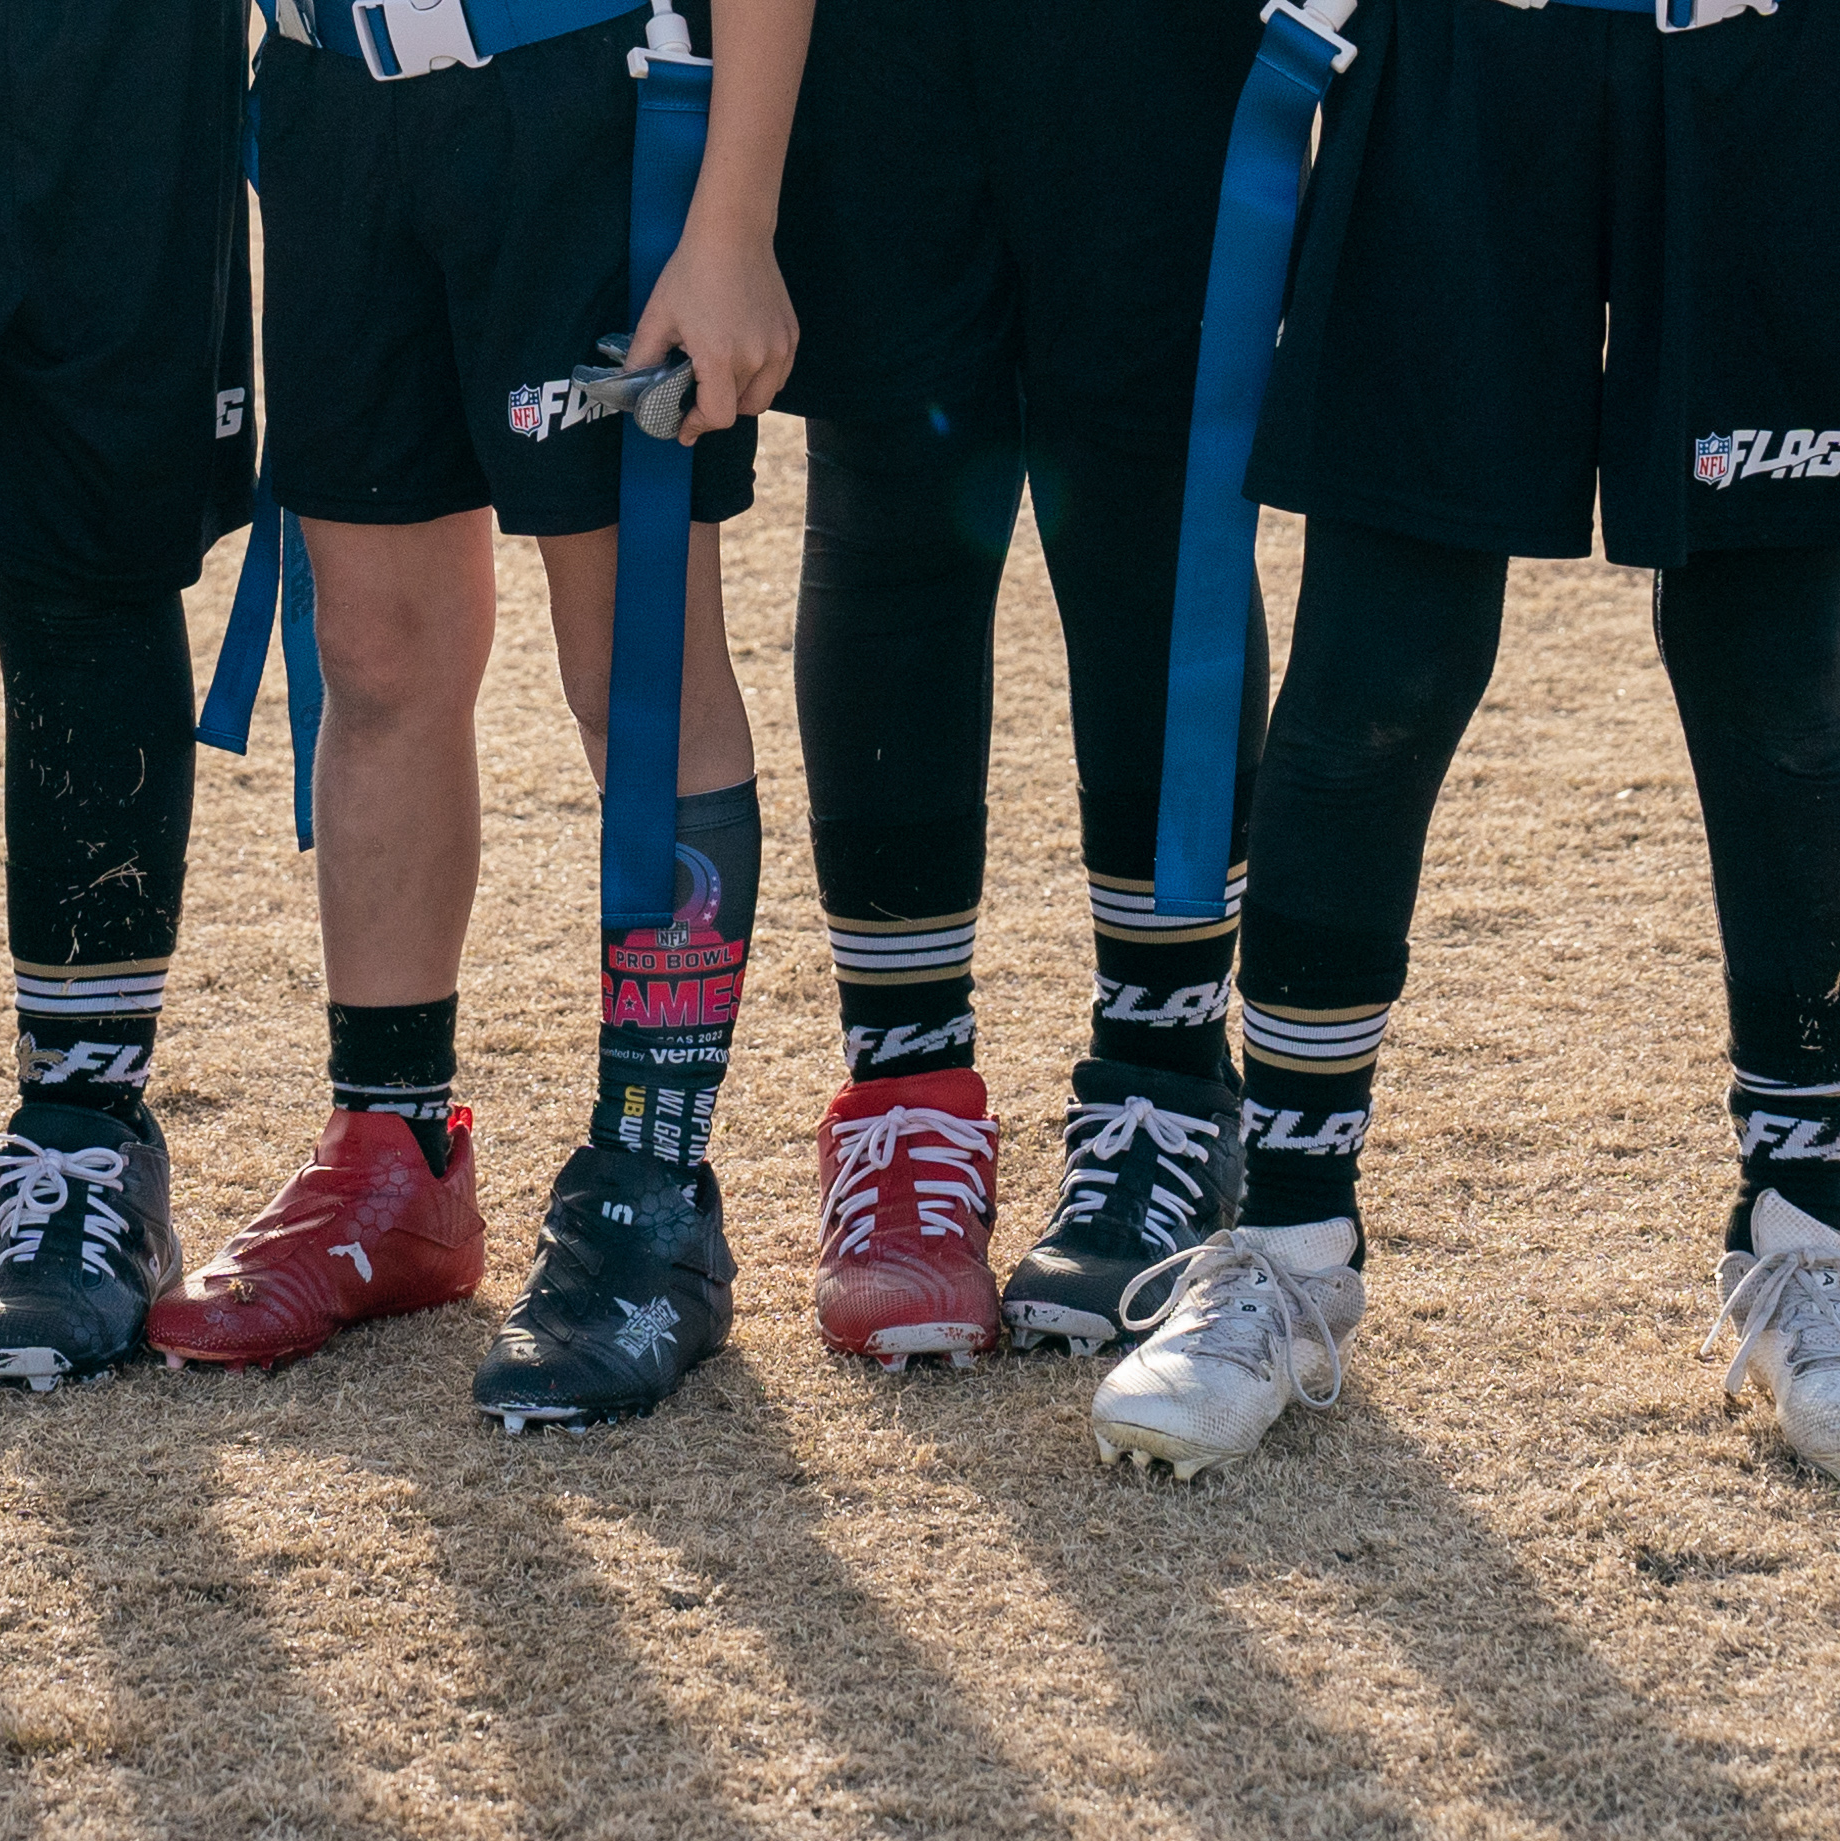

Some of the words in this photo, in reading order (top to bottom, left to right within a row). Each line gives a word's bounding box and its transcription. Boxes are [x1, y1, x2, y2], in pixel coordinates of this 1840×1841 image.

[512, 406, 539, 428] NFL
[1699, 456, 1726, 477] NFL
[659, 931, 688, 946] NFL
[616, 951, 656, 969] PRO
[666, 947, 732, 969] BOWL
[698, 1030, 723, 1044] 2023
[632, 1048, 645, 1061] by
